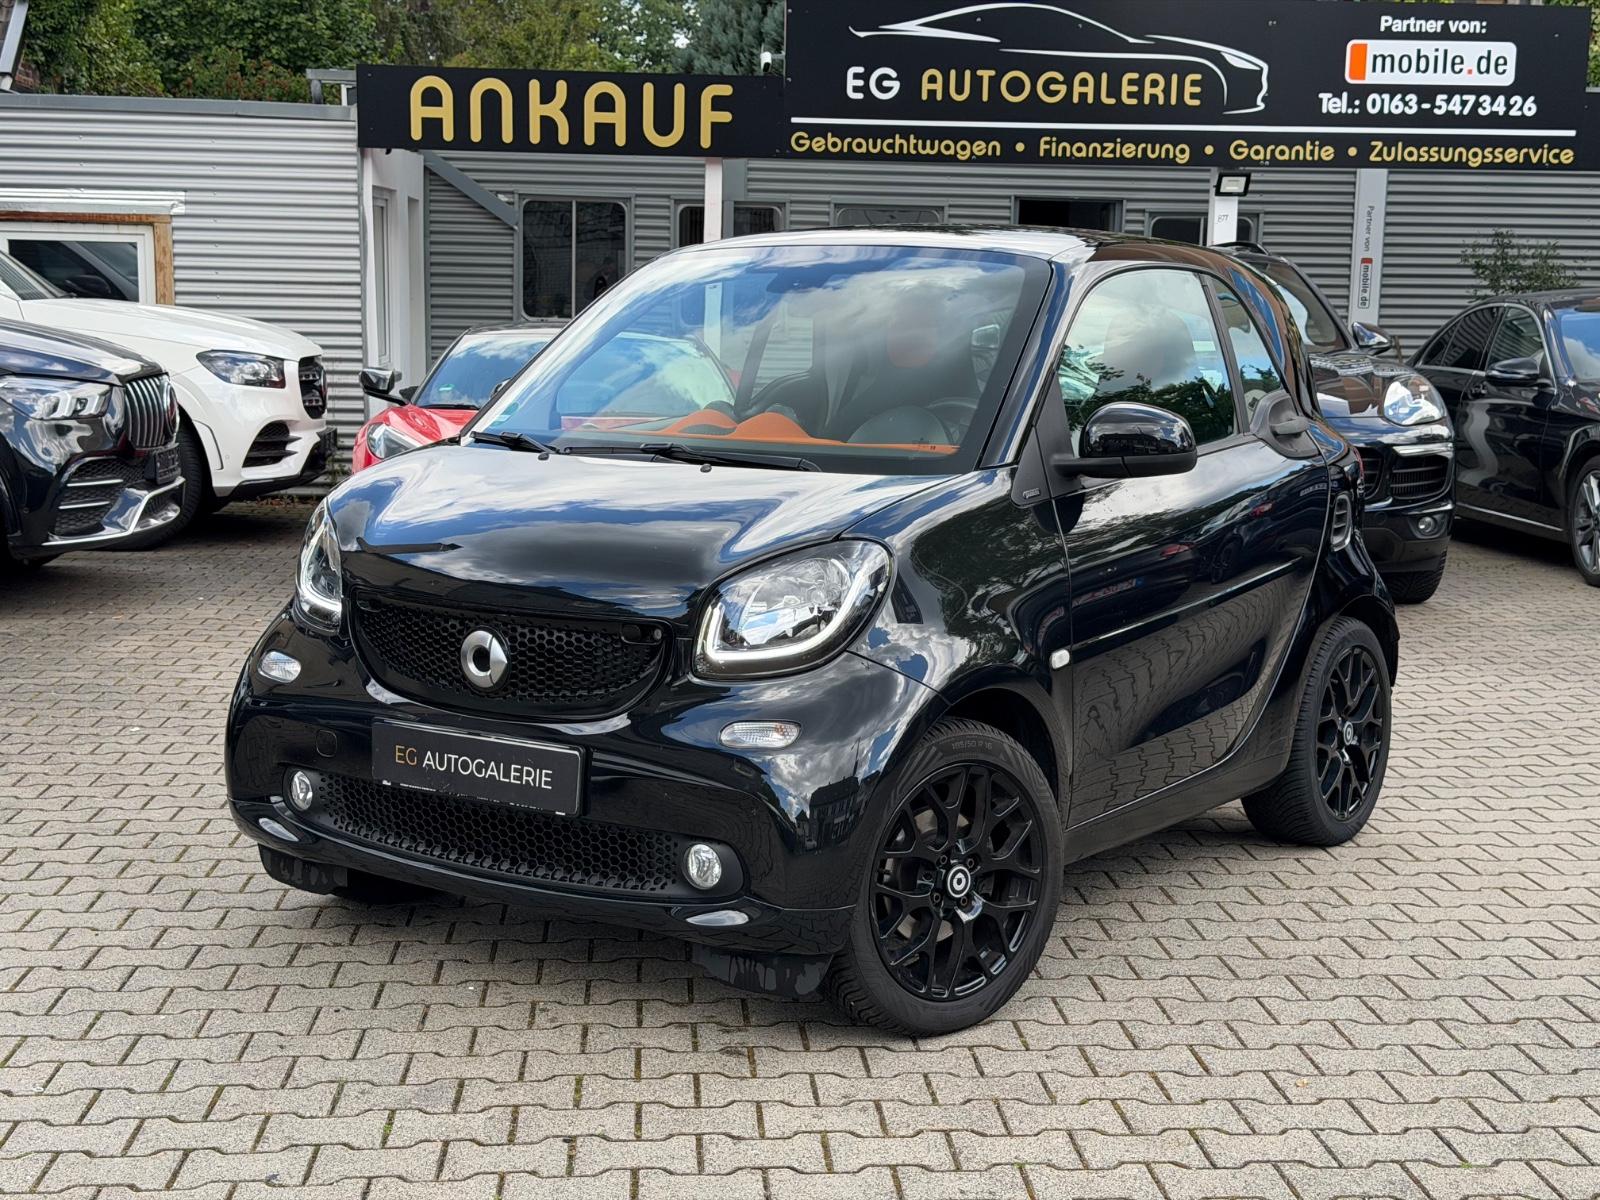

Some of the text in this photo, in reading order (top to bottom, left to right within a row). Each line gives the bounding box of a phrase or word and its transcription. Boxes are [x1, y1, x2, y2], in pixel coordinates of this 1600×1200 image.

[1380, 15, 1487, 34] Partner von:
[1371, 48, 1508, 75] mobile.de
[845, 66, 1202, 106] EG AUTOGALERIE
[1319, 92, 1360, 114] Tel.:
[409, 75, 734, 150] ANKAUF
[790, 130, 1575, 168] Gebrauchtwagen Finanzierung Garantie Zulassungsservice
[1360, 205, 1375, 307] Partner von mobile.de
[395, 745, 553, 789] EG AUTOGALERIE
